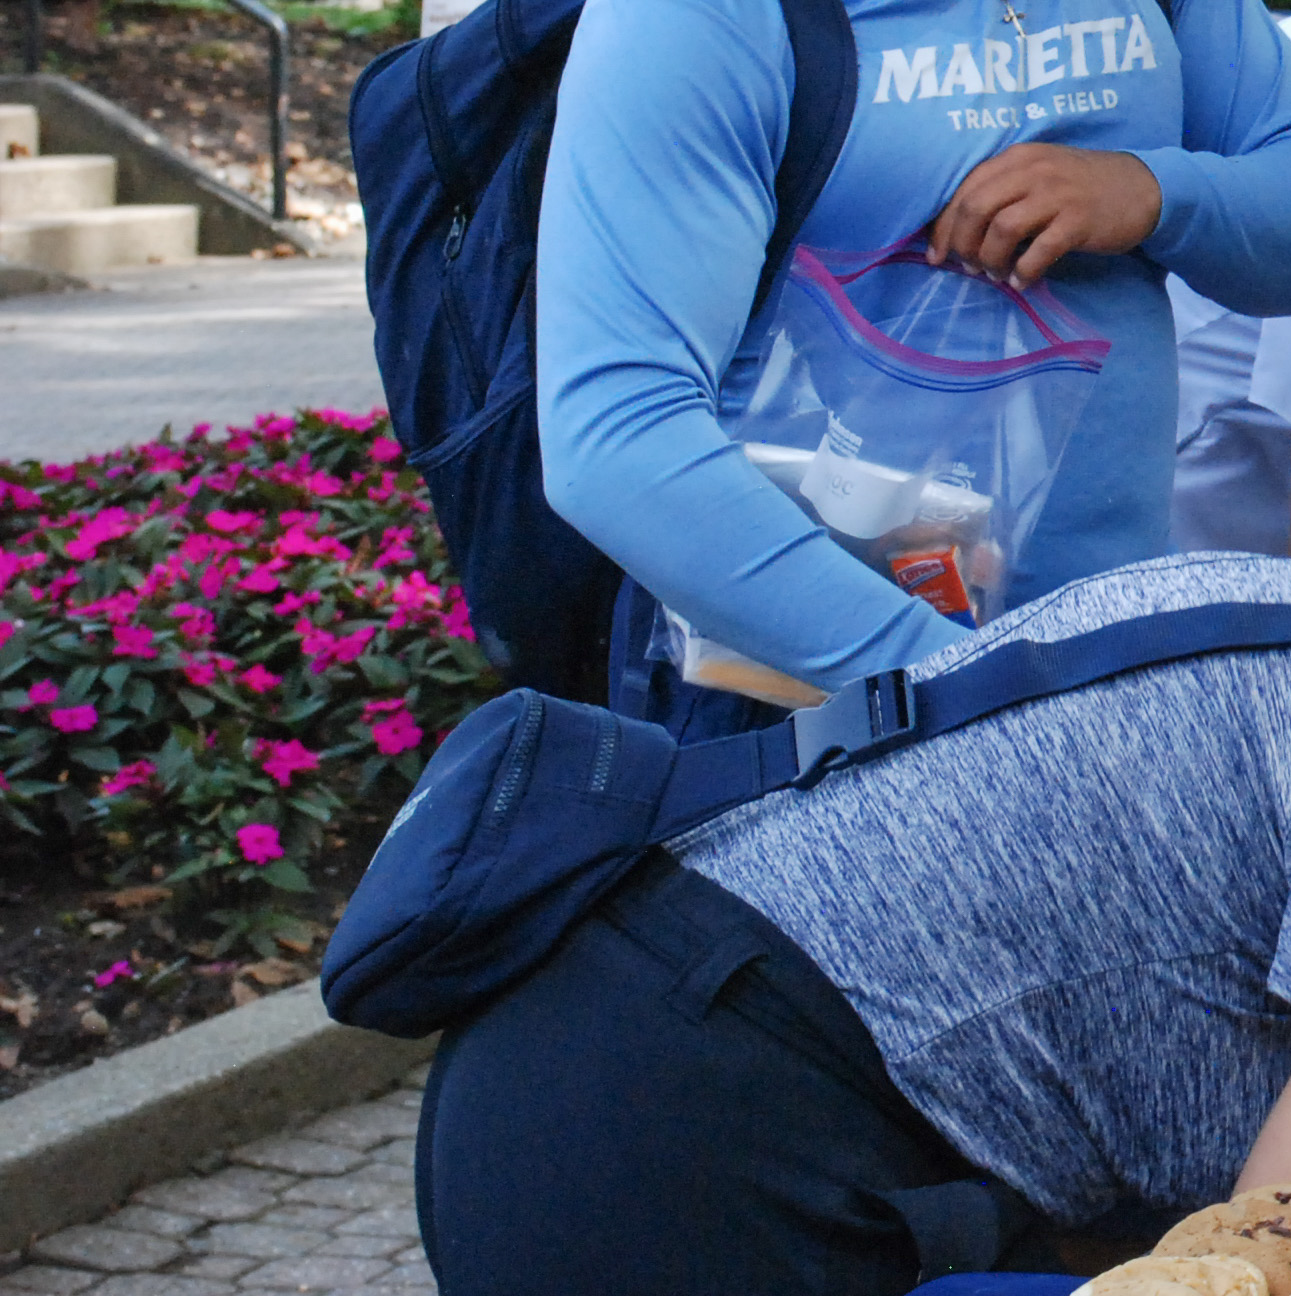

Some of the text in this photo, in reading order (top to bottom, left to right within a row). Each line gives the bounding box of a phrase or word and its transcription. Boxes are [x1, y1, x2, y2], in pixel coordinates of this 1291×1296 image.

[872, 14, 1158, 104] MARIETTA
[1025, 103, 1048, 120] &
[1053, 89, 1119, 114] FIELD
